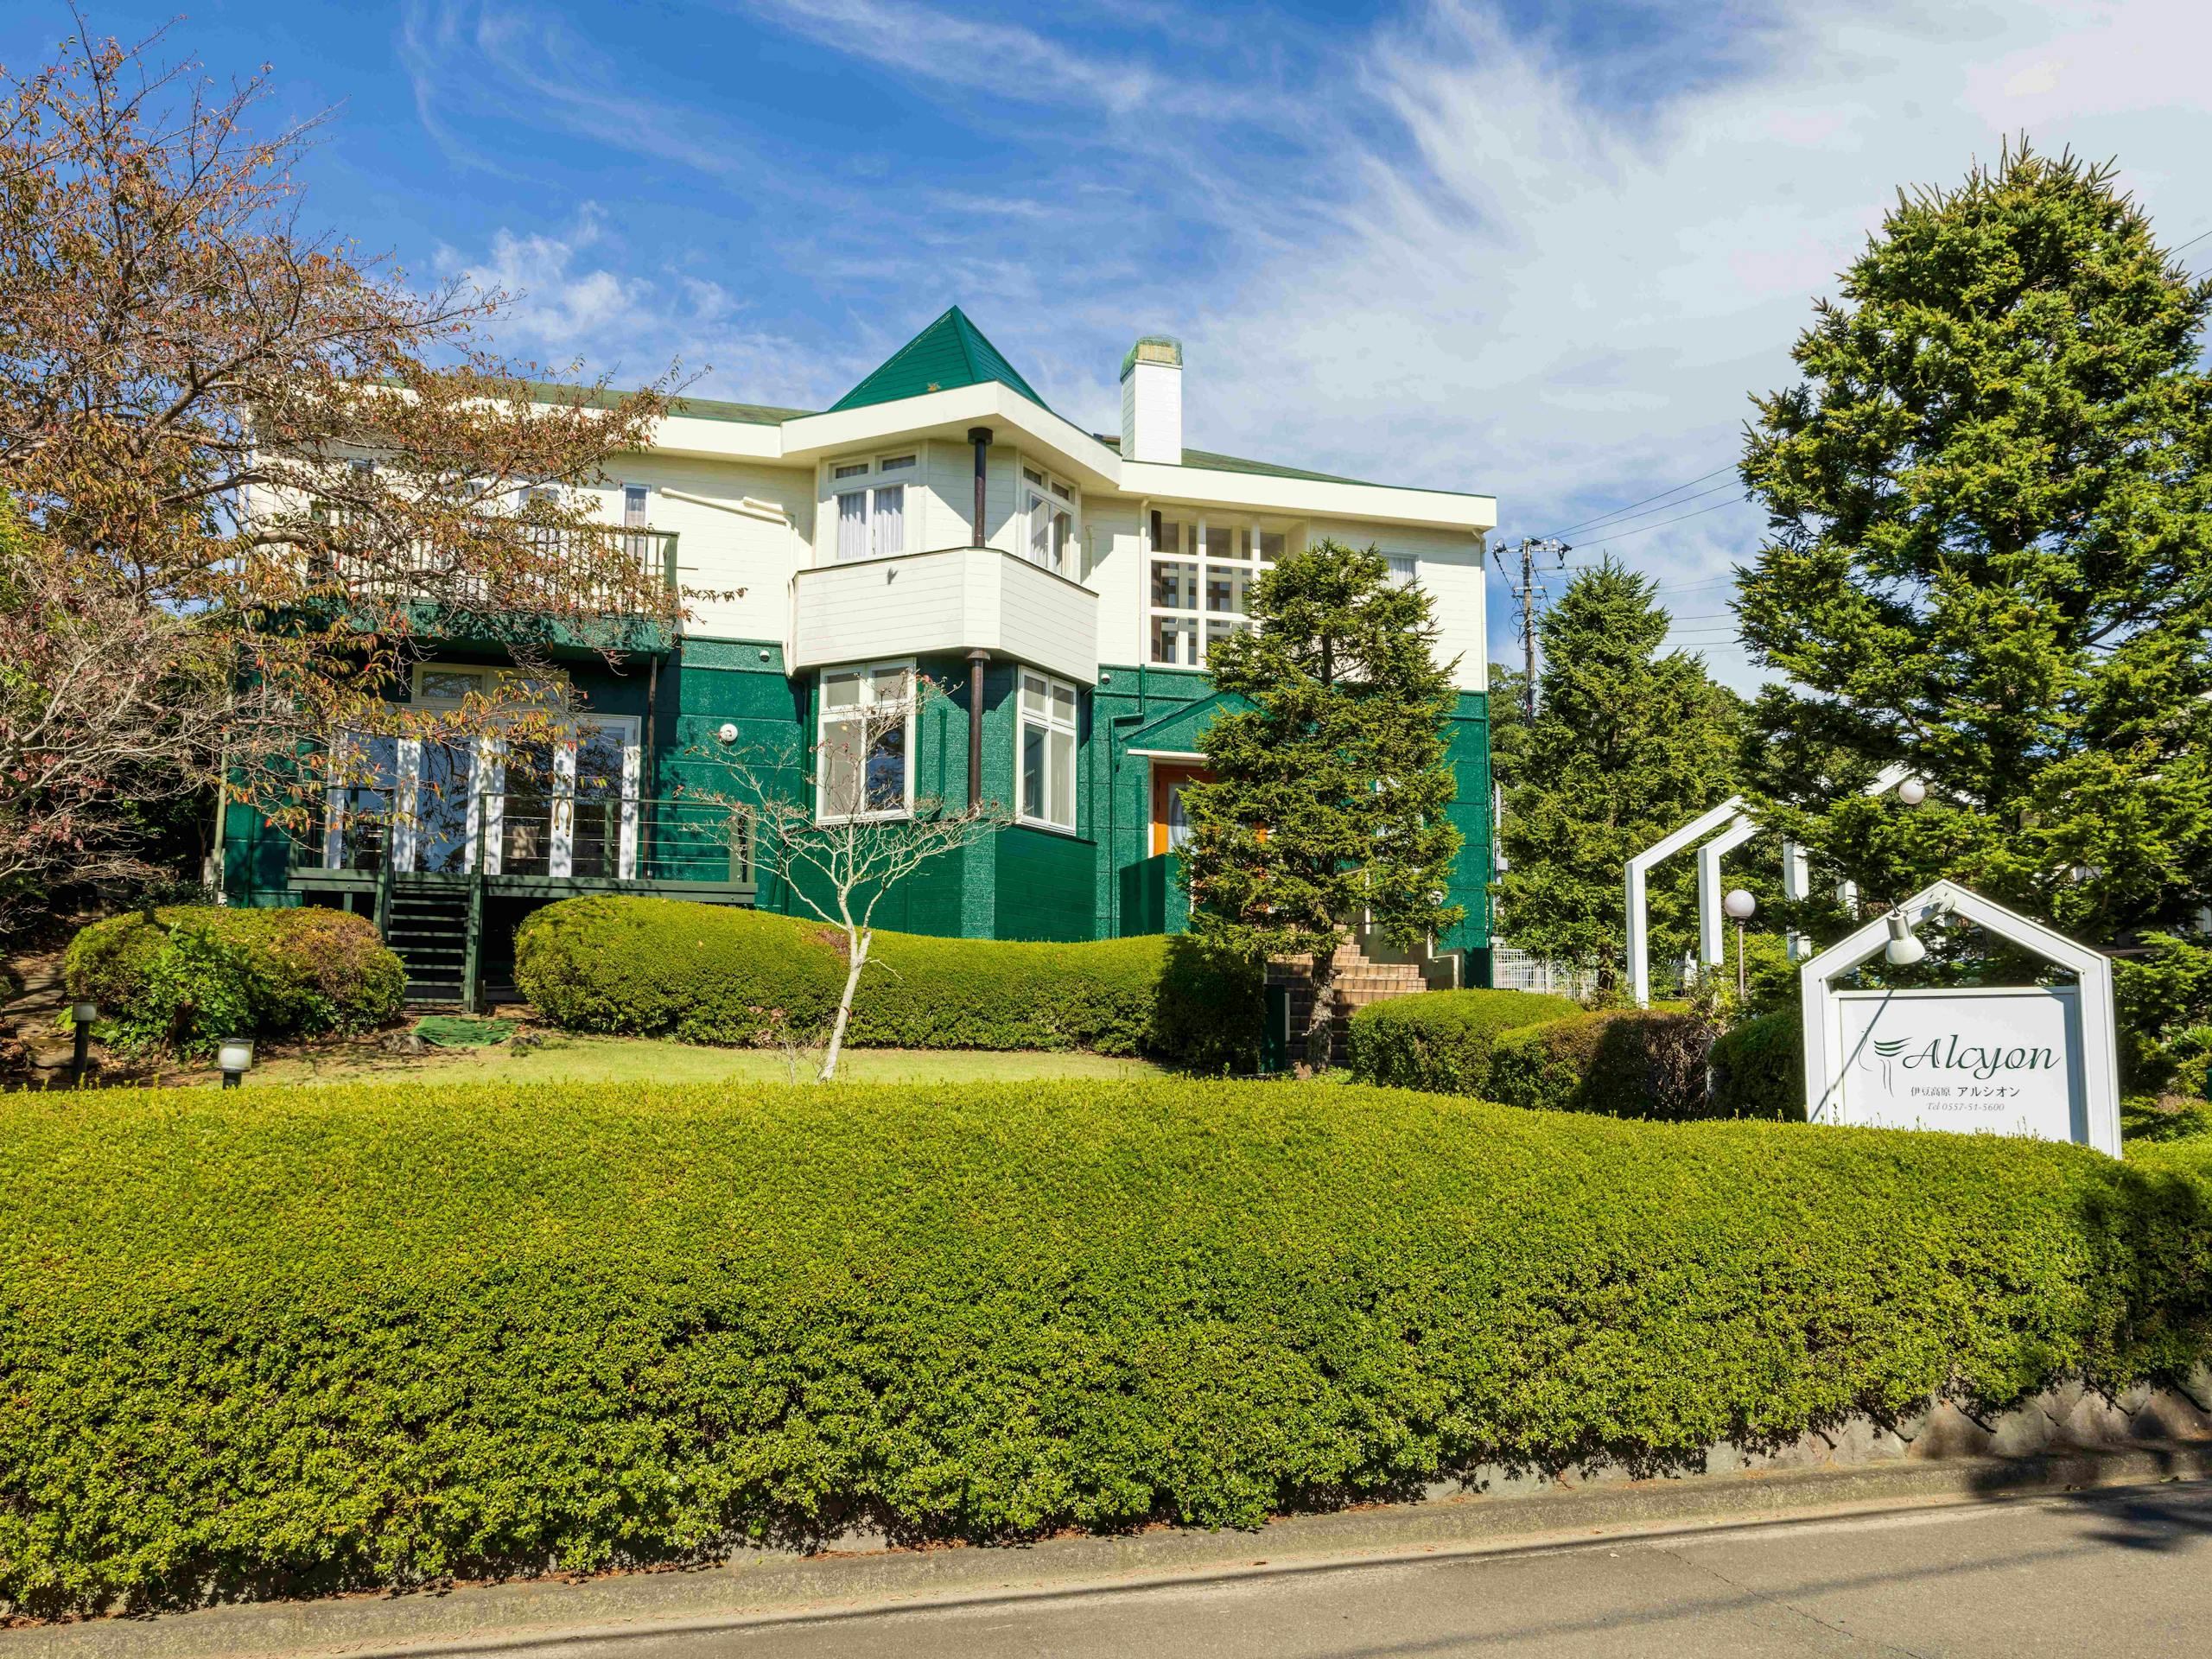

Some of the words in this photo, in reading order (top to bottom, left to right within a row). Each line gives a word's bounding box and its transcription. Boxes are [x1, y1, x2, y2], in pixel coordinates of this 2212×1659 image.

[1903, 1034, 2060, 1080] Alcyon
[1910, 1086, 1951, 1097] 伊豆高原
[1957, 1086, 2020, 1097] アルシオン
[1927, 1102, 1940, 1111] Tel
[1942, 1103, 2005, 1112] 0557-51-5600
